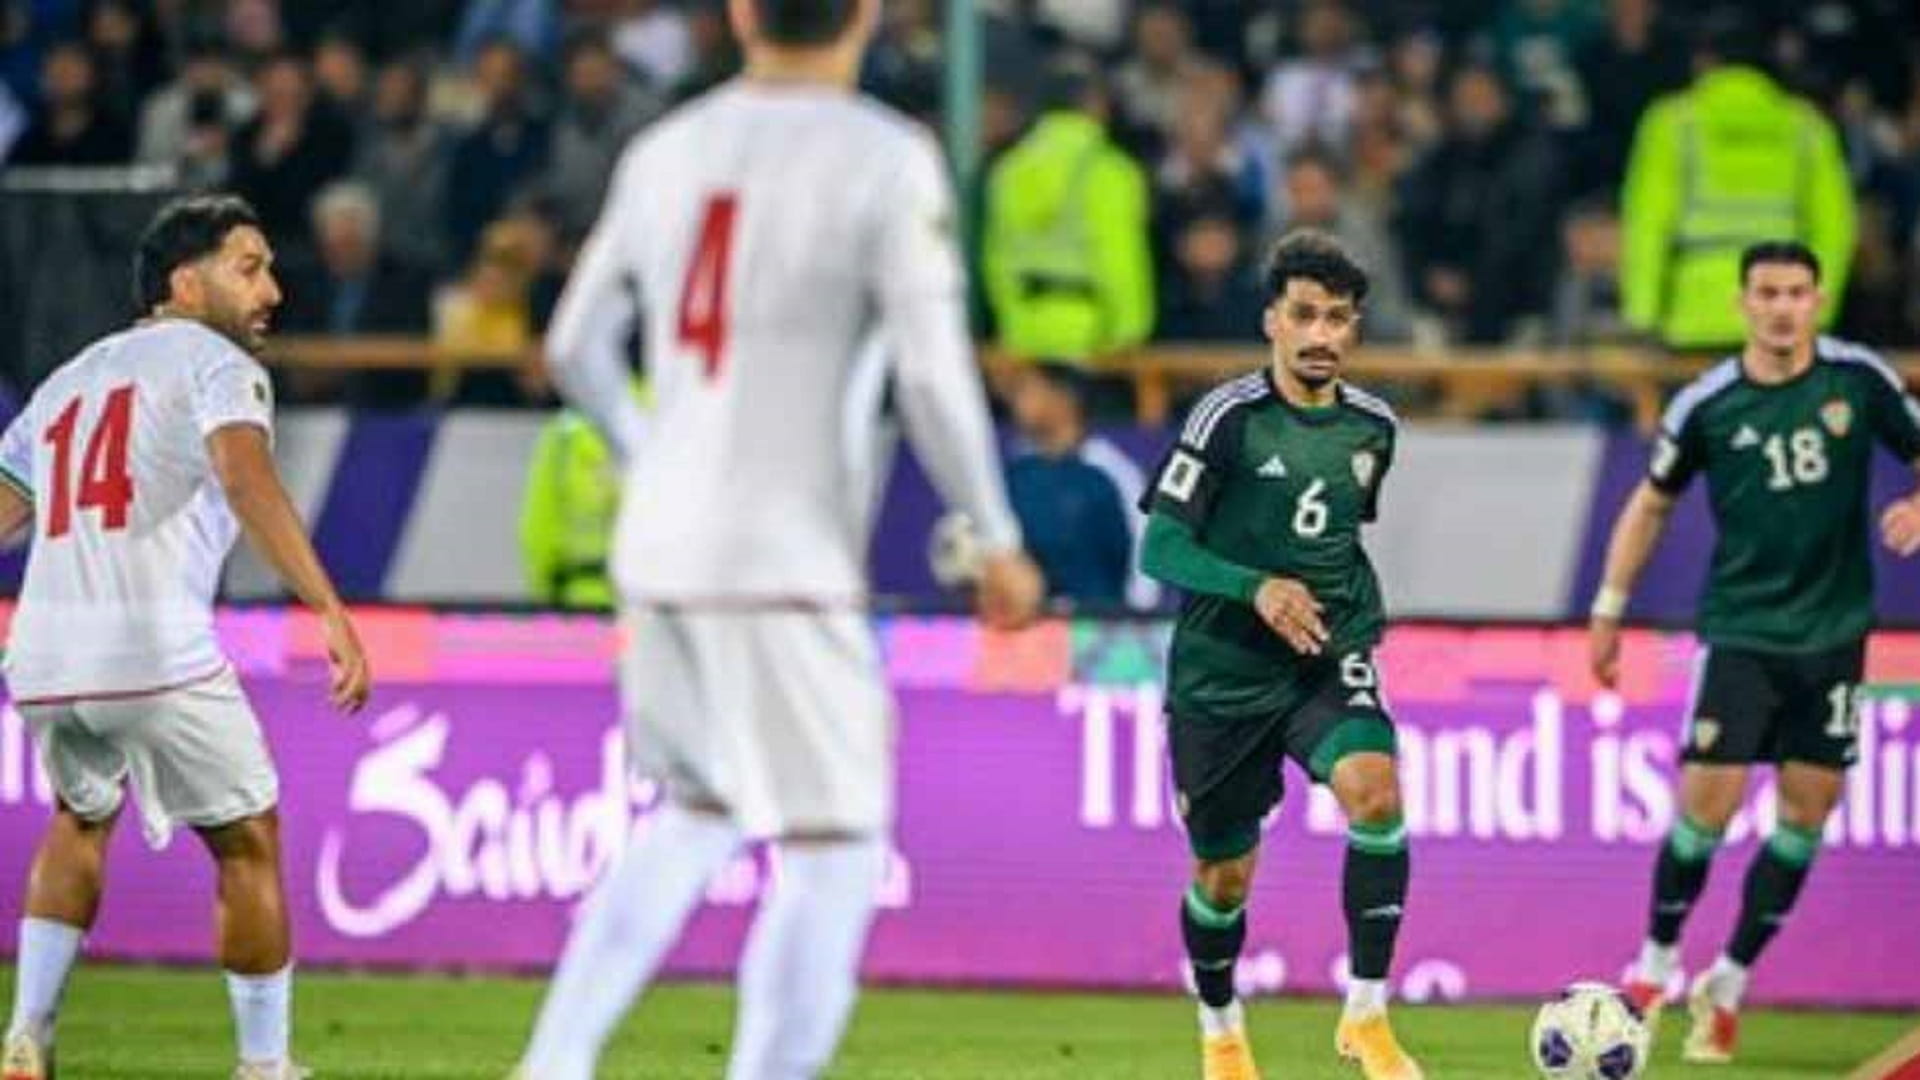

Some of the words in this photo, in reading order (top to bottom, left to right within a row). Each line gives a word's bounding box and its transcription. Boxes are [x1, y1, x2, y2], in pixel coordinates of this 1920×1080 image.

[677, 191, 741, 381] 4
[44, 383, 136, 538] 14
[1764, 427, 1828, 490] 18
[1293, 479, 1328, 538] 6
[1341, 650, 1374, 688] 6
[1824, 682, 1860, 736] 1
